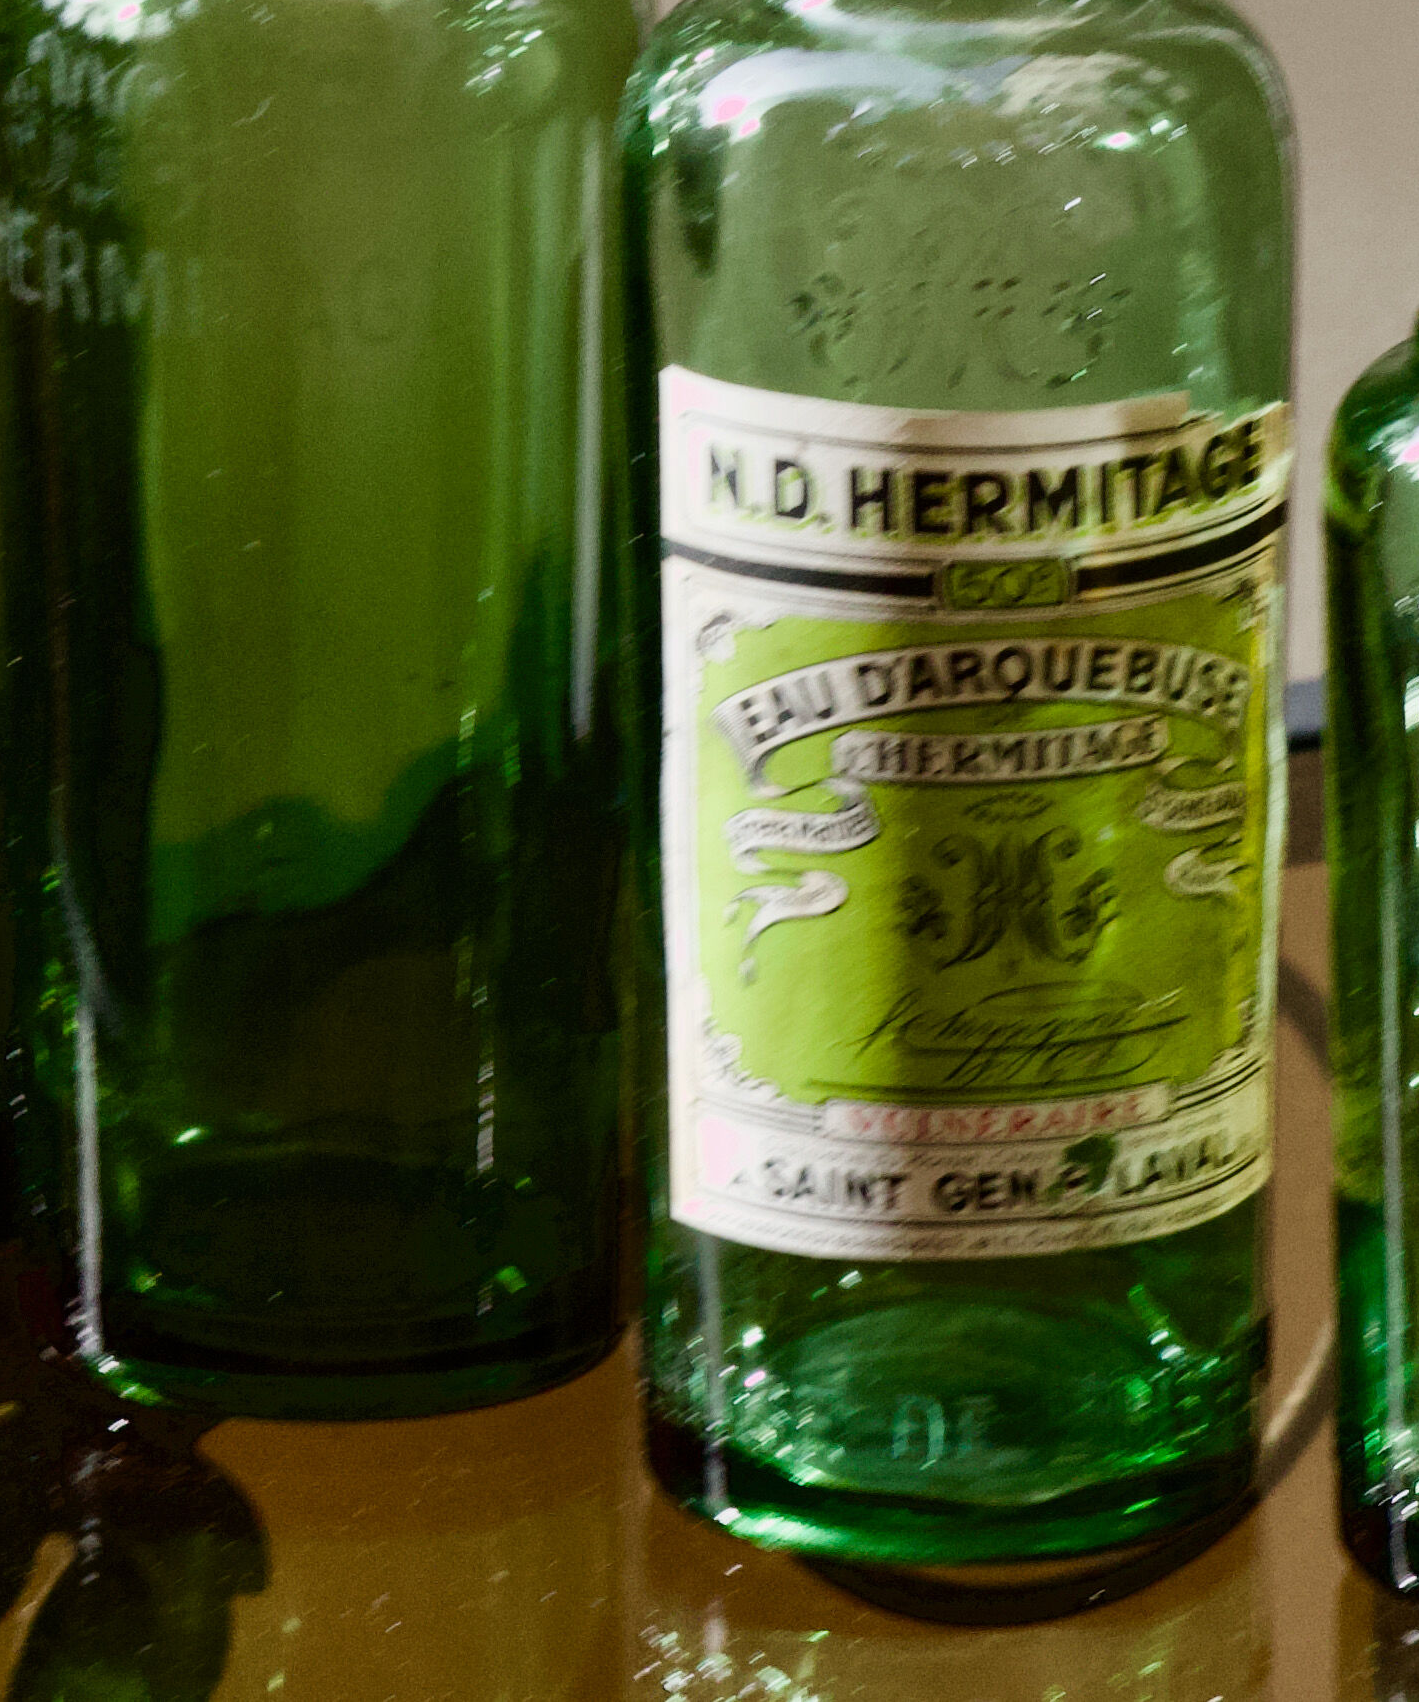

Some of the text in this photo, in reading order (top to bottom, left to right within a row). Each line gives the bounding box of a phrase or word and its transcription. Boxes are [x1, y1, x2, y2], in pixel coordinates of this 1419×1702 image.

[707, 418, 1266, 538] N.D. HERMITAGE
[739, 670, 836, 744] EAU
[762, 1155, 908, 1212] SAINT
